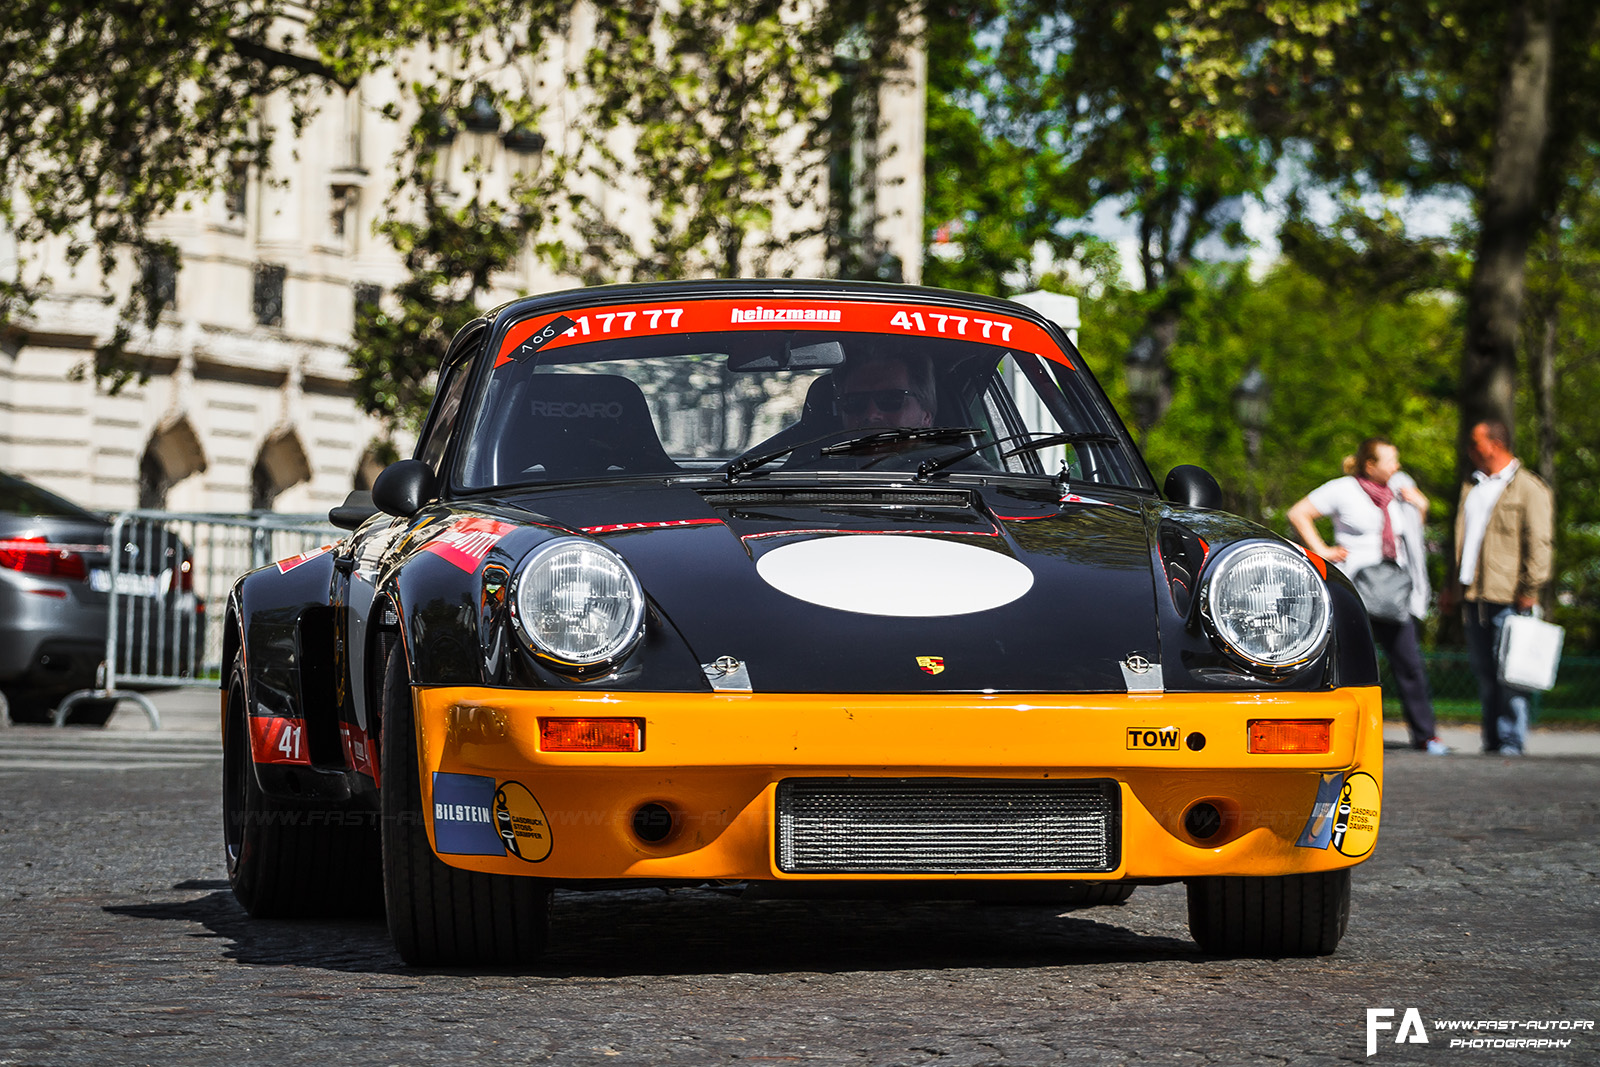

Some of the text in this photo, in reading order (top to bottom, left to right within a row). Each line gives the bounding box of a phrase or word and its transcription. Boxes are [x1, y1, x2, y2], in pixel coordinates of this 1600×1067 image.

[731, 306, 841, 323] heinzmann
[530, 400, 624, 418] RECARO
[278, 726, 301, 759] 41
[1128, 730, 1178, 747] TOW
[435, 803, 491, 823] BILSTEIN
